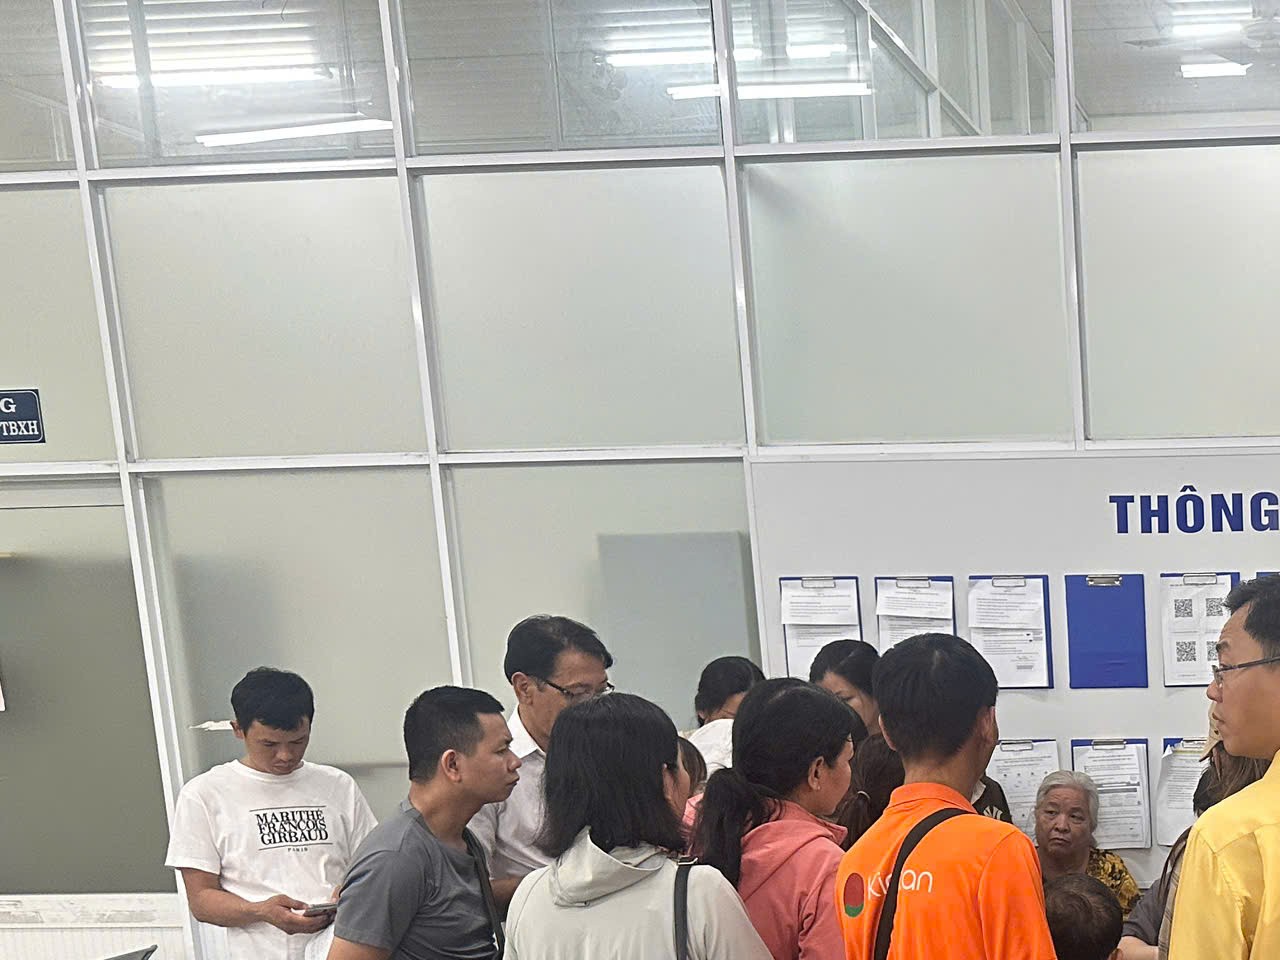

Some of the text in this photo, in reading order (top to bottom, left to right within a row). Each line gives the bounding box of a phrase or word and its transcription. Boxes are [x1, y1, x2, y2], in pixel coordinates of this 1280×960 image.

[0, 420, 39, 436] TBXH
[1109, 484, 1280, 534] THÔNG
[261, 829, 329, 845] GIRBAUD
